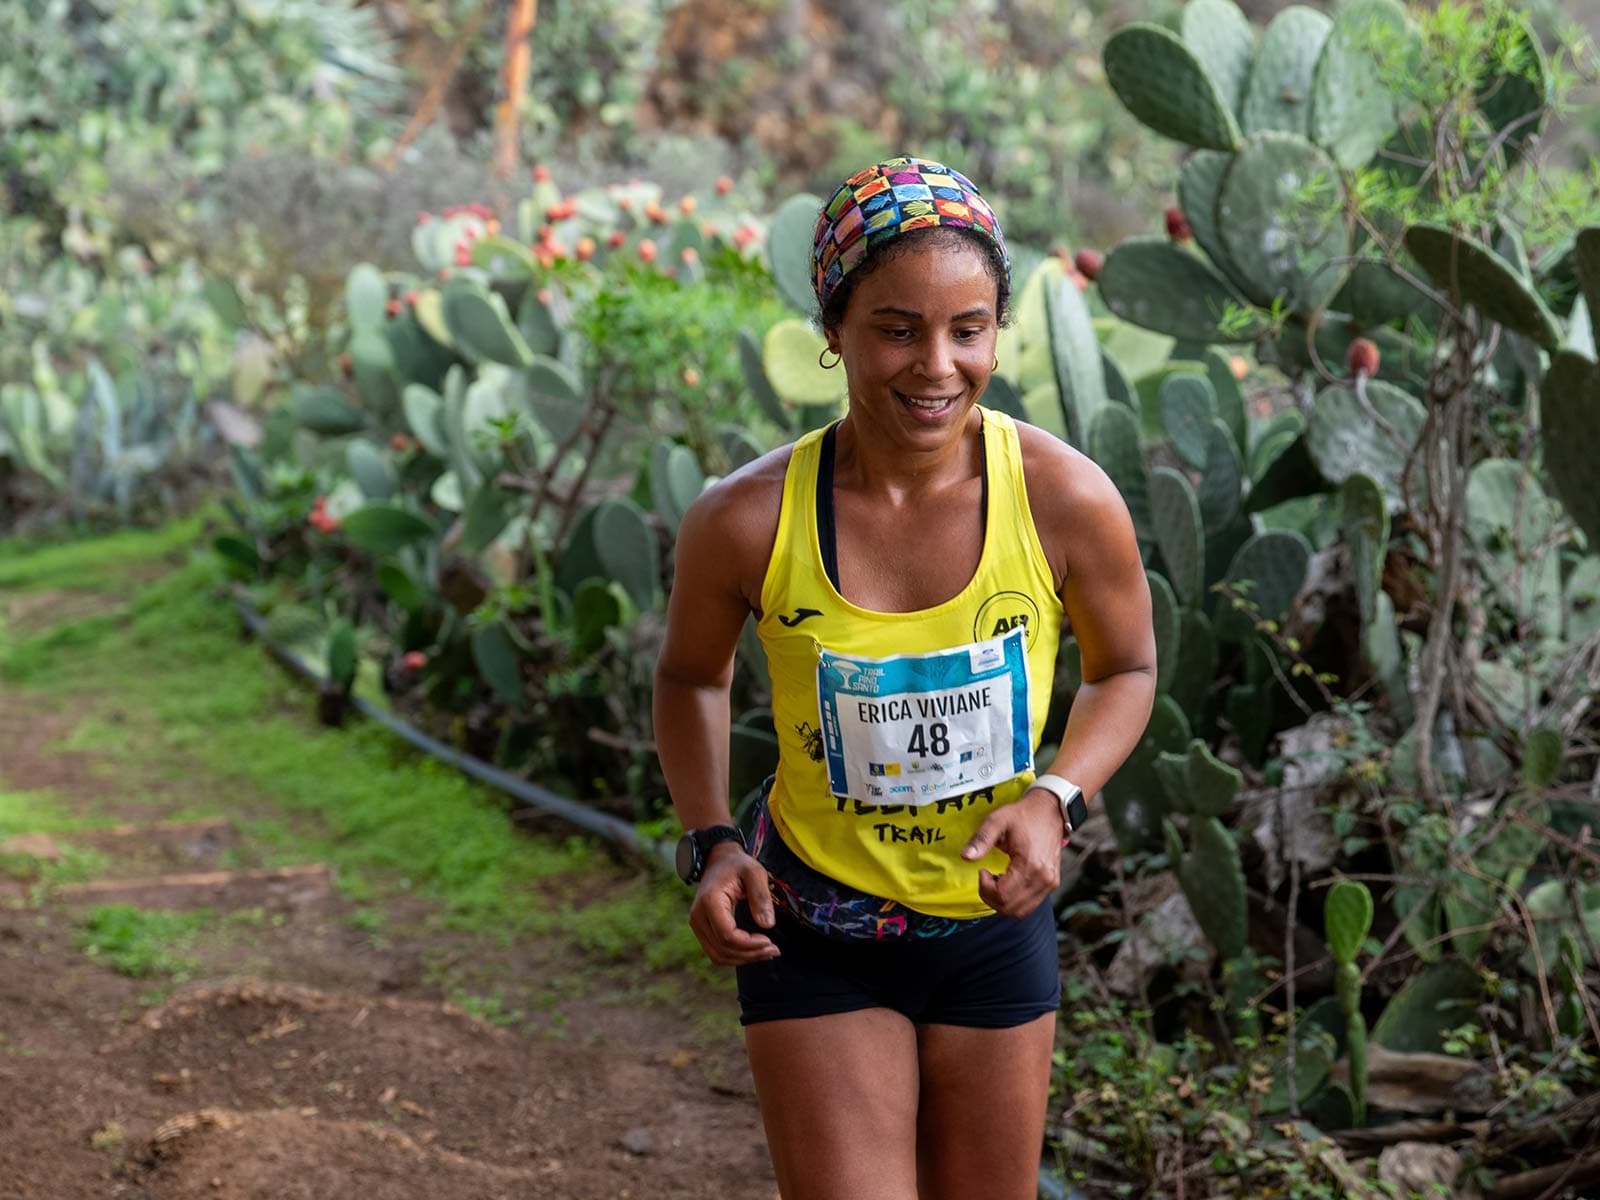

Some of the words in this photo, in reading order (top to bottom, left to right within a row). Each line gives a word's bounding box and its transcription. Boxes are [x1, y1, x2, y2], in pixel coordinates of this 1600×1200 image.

[852, 682, 880, 694] SANTO
[858, 700, 912, 724] ERICA
[917, 687, 992, 719] VIVIANE
[907, 723, 950, 758] 48
[873, 823, 946, 845] TRAIL
